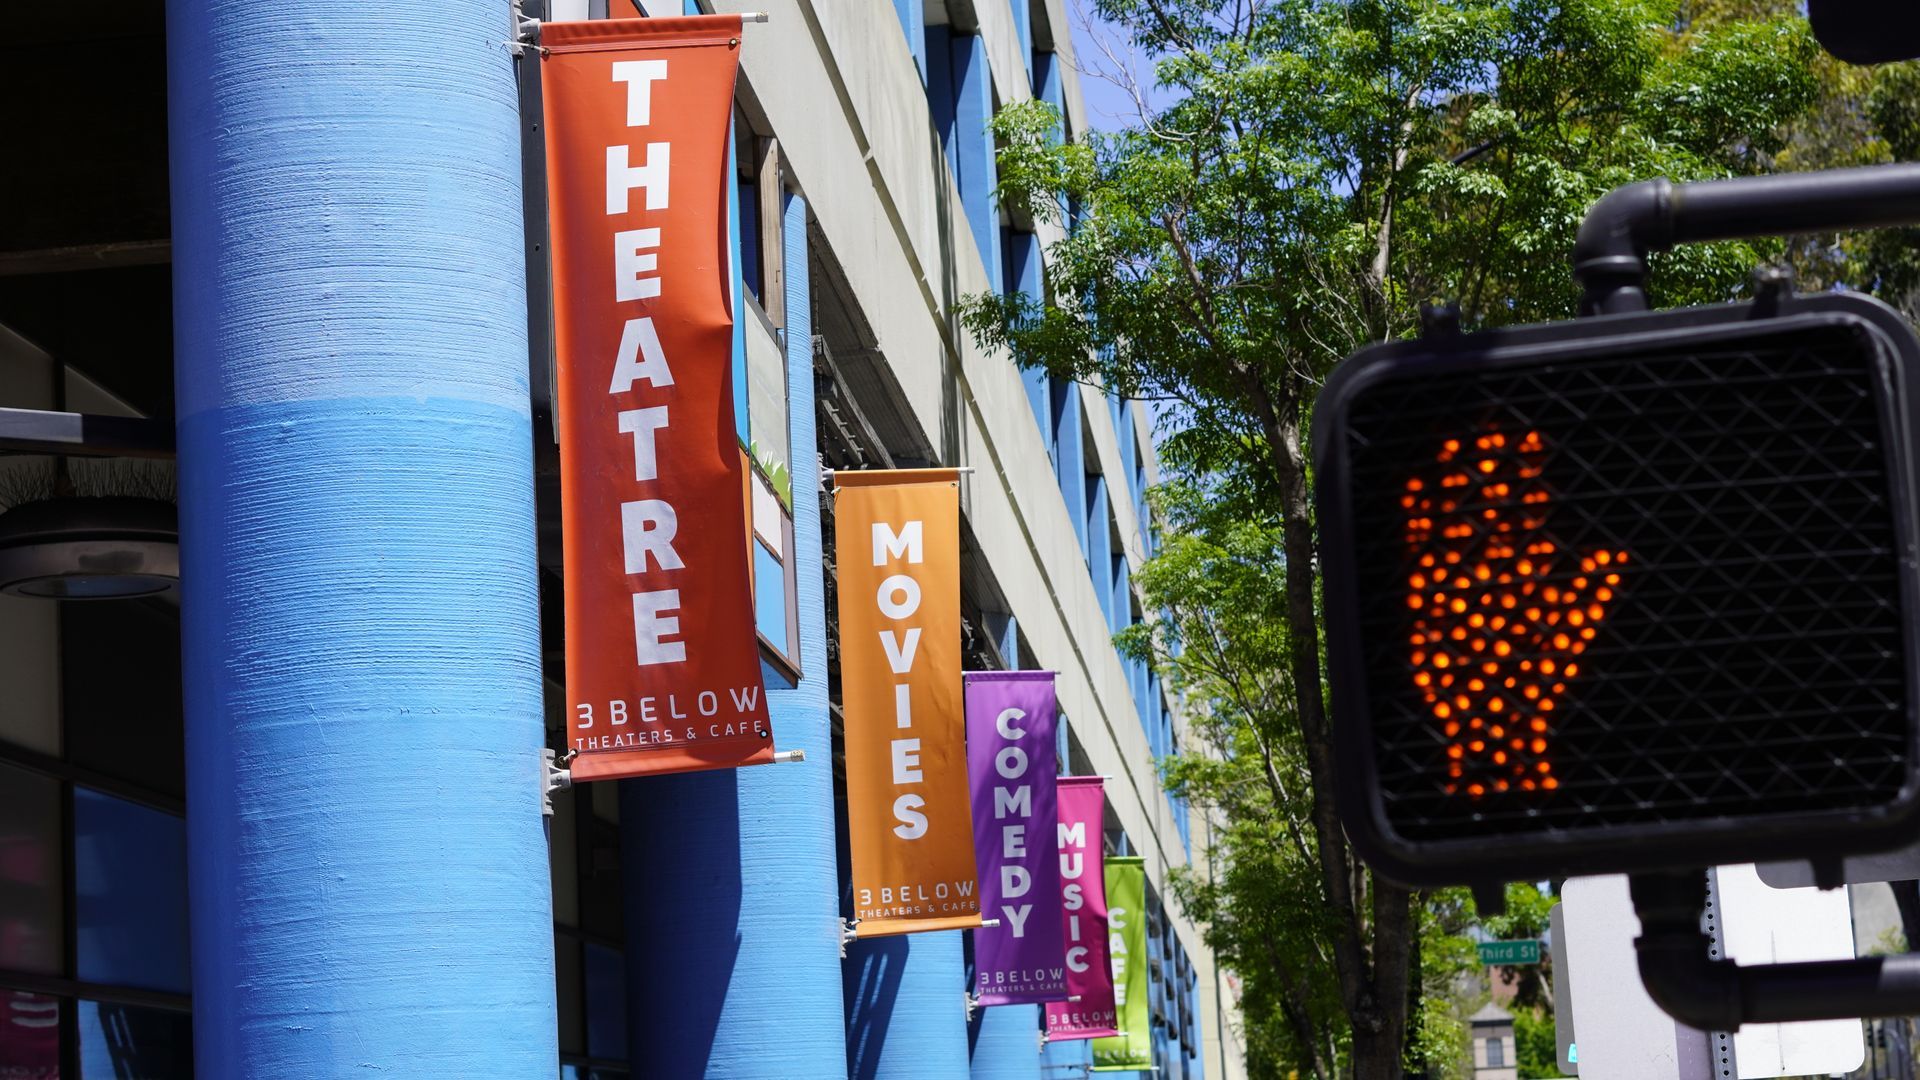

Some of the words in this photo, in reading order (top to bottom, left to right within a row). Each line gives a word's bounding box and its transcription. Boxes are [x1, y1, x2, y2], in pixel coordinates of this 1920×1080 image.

[606, 59, 687, 666] THEATRE
[871, 520, 928, 840] MOVIES
[576, 729, 673, 750] THEATERS
[686, 727, 696, 740] &
[710, 720, 762, 737] CAFE
[994, 708, 1033, 938] COMEDY
[860, 906, 920, 919] THEATERS
[928, 904, 935, 913] &
[942, 901, 976, 912] CAFE
[1057, 822, 1090, 973] MUSIC
[980, 984, 1025, 994] THEATERS
[1040, 982, 1064, 991] CAFE
[1107, 907, 1128, 1006] CAFE
[1480, 947, 1514, 960] Third
[1521, 945, 1535, 958] St
